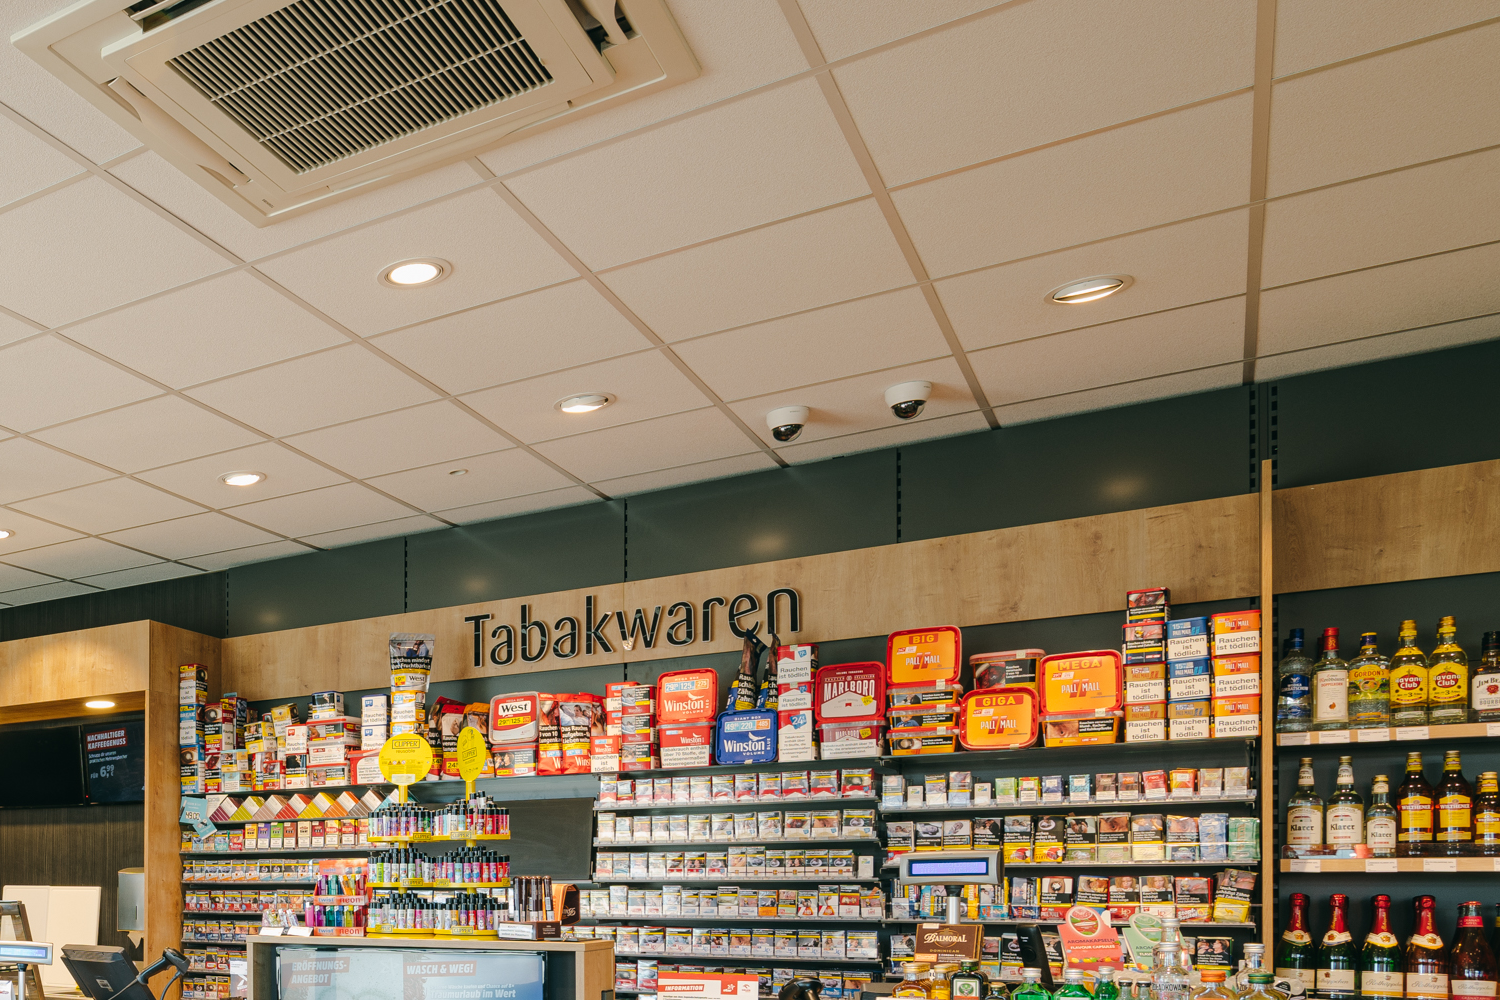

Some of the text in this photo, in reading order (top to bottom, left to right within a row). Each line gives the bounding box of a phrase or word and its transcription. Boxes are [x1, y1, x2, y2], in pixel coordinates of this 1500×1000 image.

[464, 587, 800, 668] Tabakwaren
[912, 634, 935, 643] BIG
[1170, 637, 1205, 645] Rauchen
[1219, 636, 1256, 644] Rauchen
[1229, 641, 1259, 650] tödlich
[905, 655, 940, 665] PALL MALL
[780, 666, 808, 674] Rauchen
[1059, 660, 1100, 671] MEGA
[788, 671, 810, 679] tödlich
[1354, 669, 1385, 678] GORDON'S
[823, 679, 875, 702] MARLBORO
[1061, 682, 1100, 694] PALL MALL
[664, 698, 704, 713] Winston
[983, 696, 1016, 706] GIGA
[501, 702, 528, 715] West
[980, 719, 1017, 730] PALL MALL
[87, 730, 125, 742] NACHHALTIGER
[88, 738, 126, 750] KAFFEEGENUSS
[393, 740, 419, 748] CLIPPER
[723, 738, 765, 753] Winston
[924, 933, 967, 943] BALMORAL
[292, 960, 347, 972] ERÖFFNUNGS-
[407, 963, 474, 975] WASCH & WEG!
[291, 974, 329, 984] ANGEBOT
[431, 989, 516, 998] Traumurlaub im Wert
